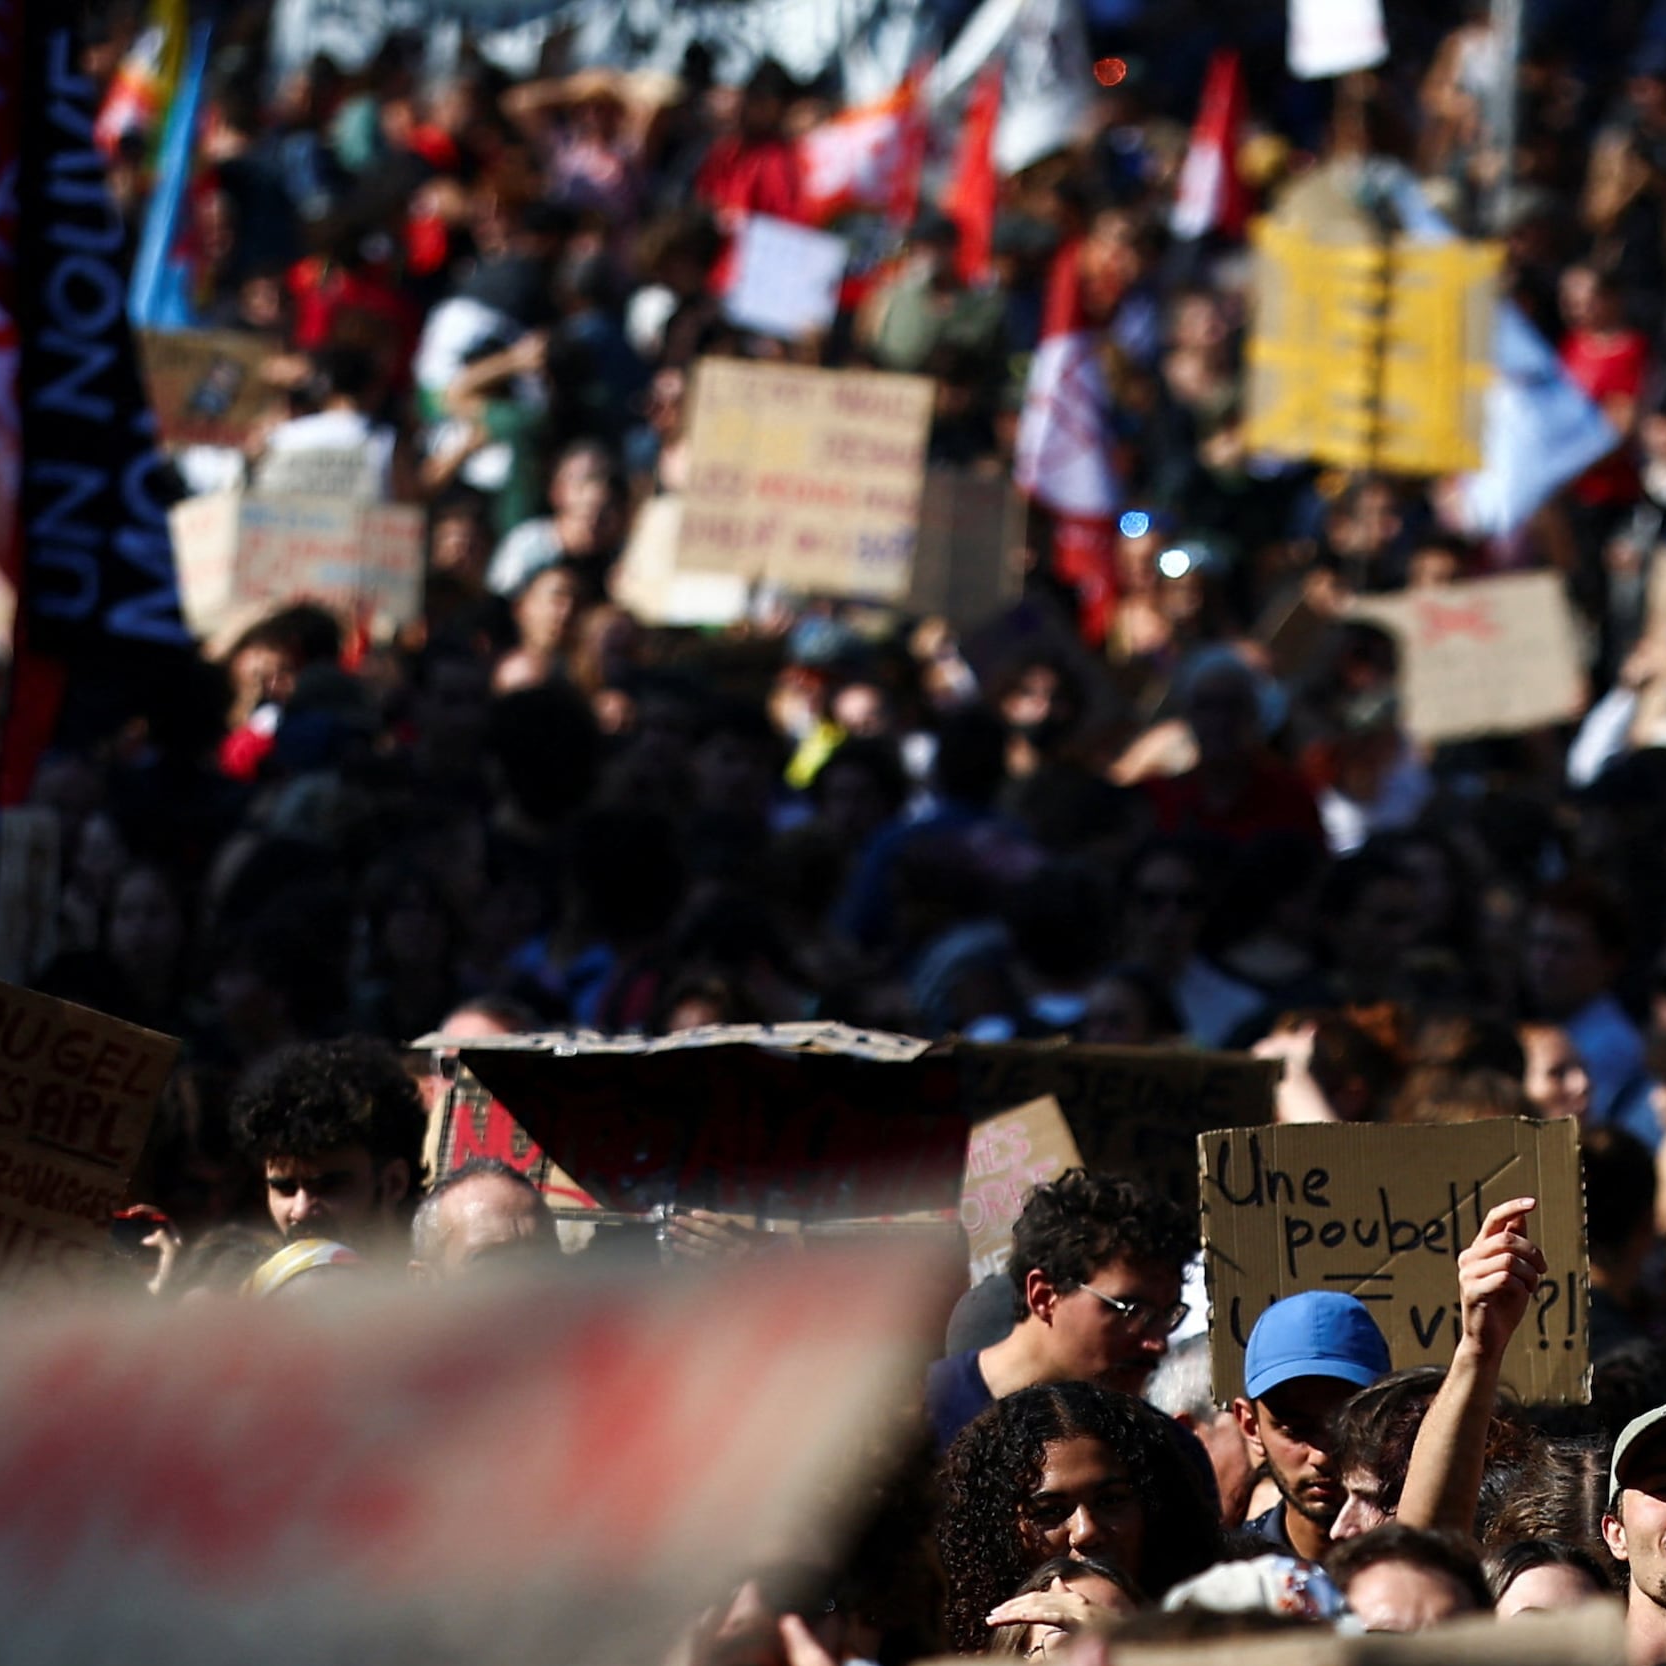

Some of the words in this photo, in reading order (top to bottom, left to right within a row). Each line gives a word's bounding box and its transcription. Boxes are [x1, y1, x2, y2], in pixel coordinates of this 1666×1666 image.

[26, 455, 113, 622] UN
[52, 1030, 153, 1098] GEL
[31, 1083, 131, 1158] APL
[1216, 1133, 1332, 1208] Une
[1283, 1180, 1485, 1280] poubell
[1409, 1295, 1464, 1350] vi
